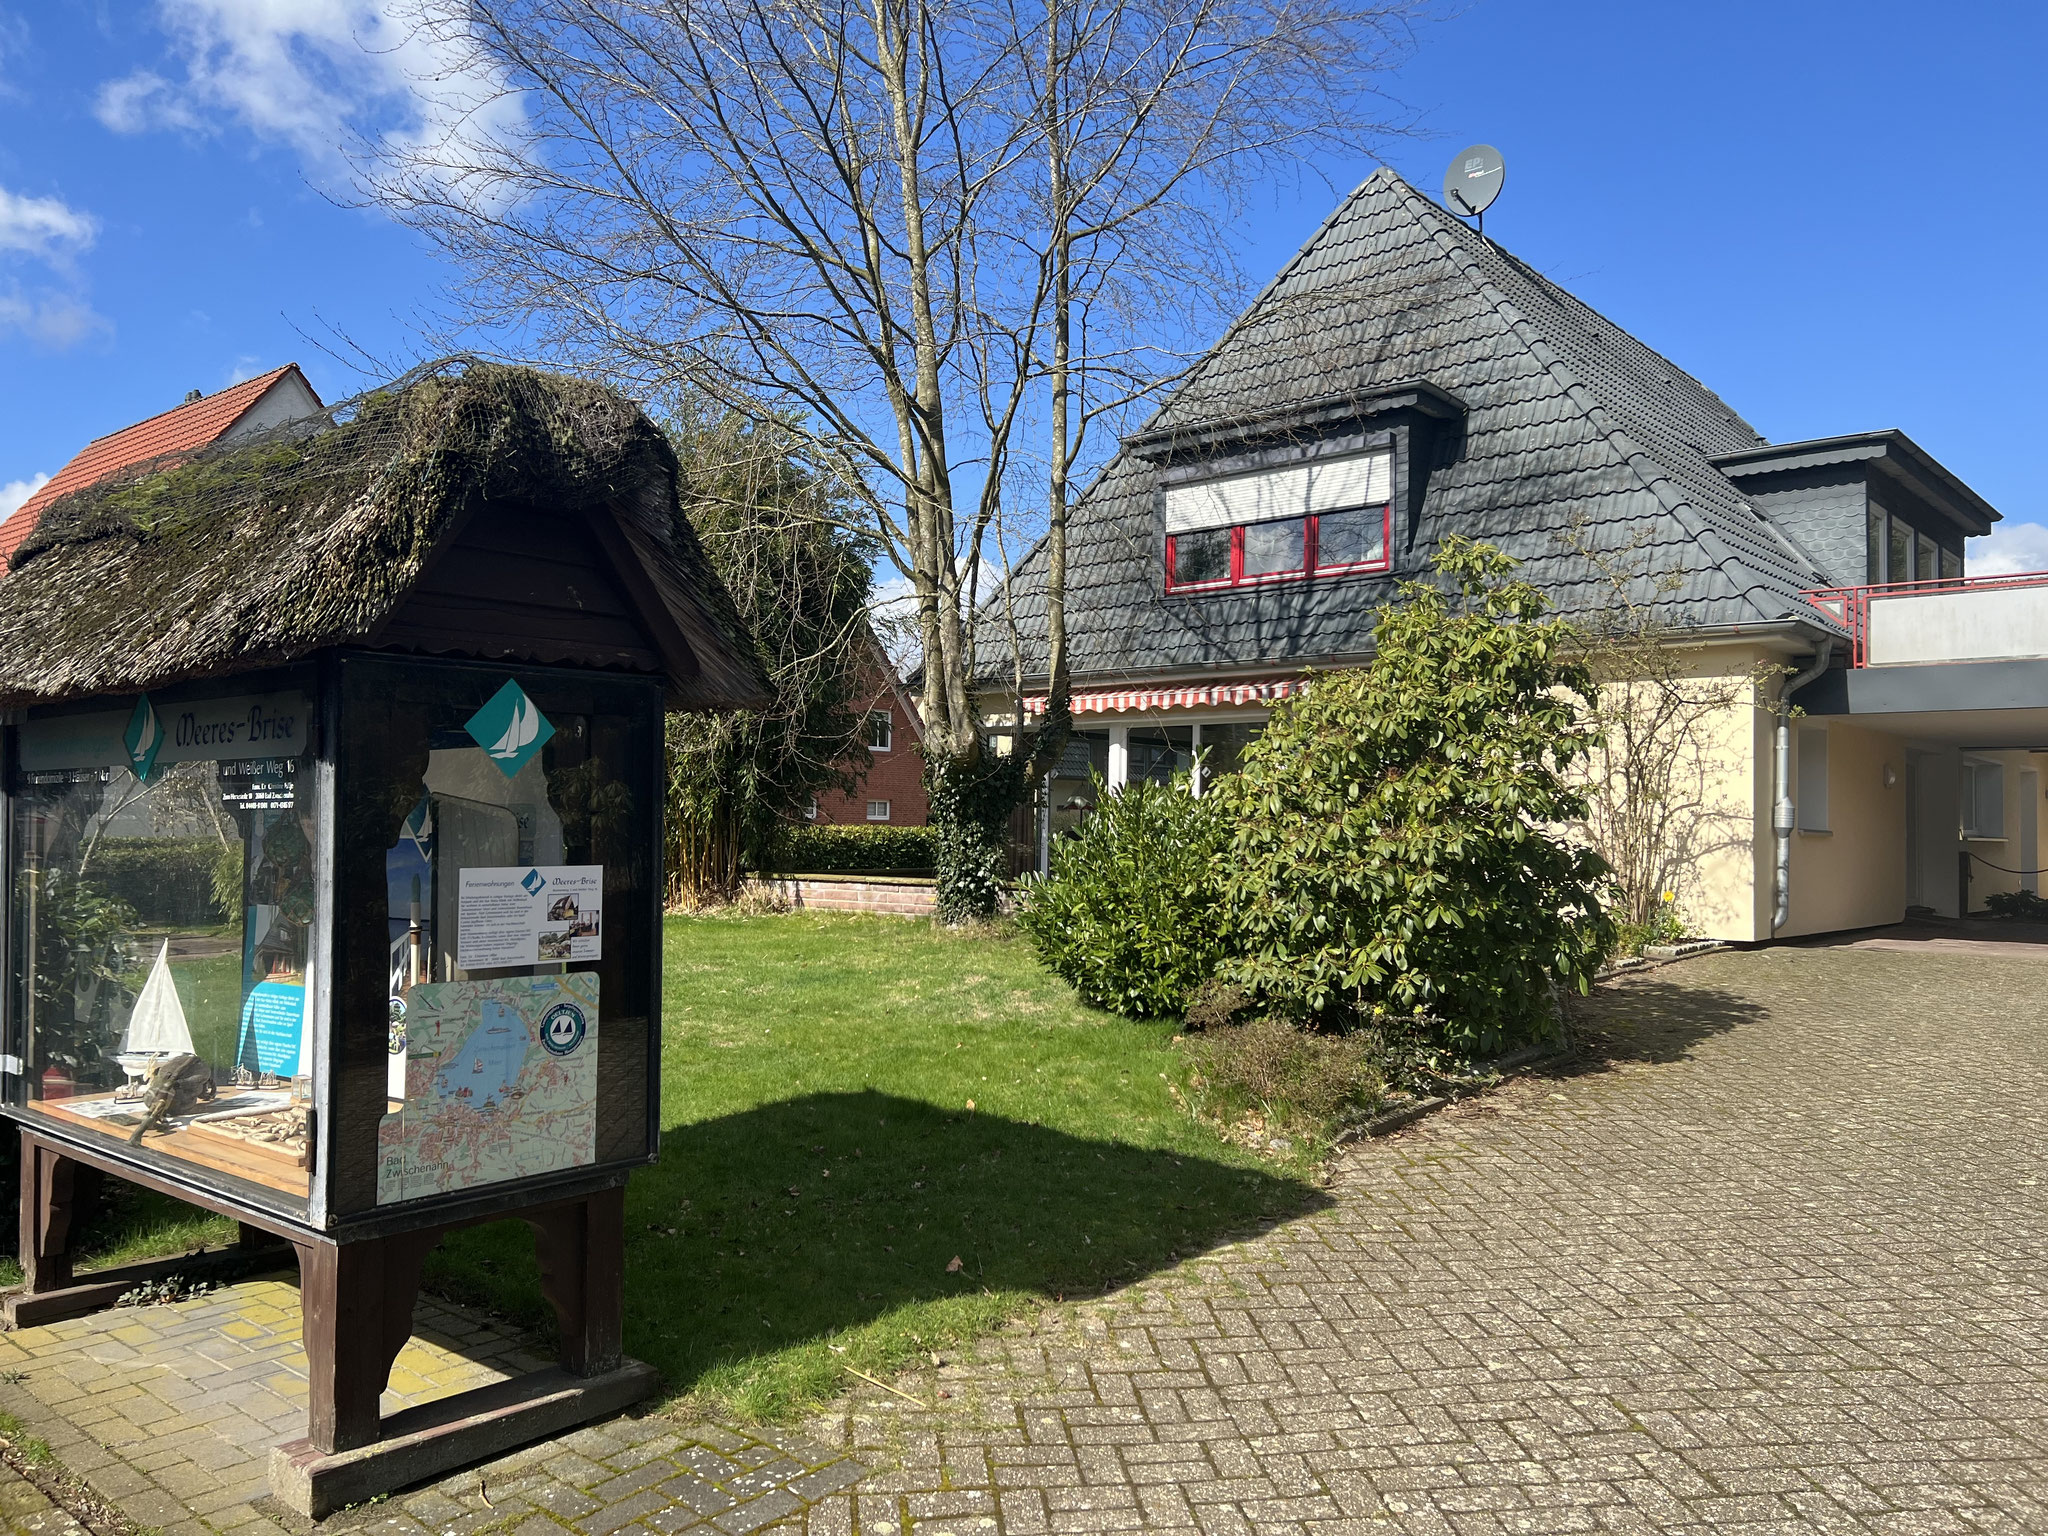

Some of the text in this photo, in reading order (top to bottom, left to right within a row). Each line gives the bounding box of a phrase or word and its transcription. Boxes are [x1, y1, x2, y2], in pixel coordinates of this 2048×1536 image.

[176, 705, 296, 747] Meeres-Brise
[222, 761, 237, 776] und
[238, 760, 265, 776] Weißer
[266, 760, 284, 778] Weg
[287, 759, 295, 773] 16
[465, 876, 598, 889] Ferienwohnungen Meeres-Brise
[386, 1154, 406, 1166] Bad
[386, 1161, 449, 1179] Zwischenahn
